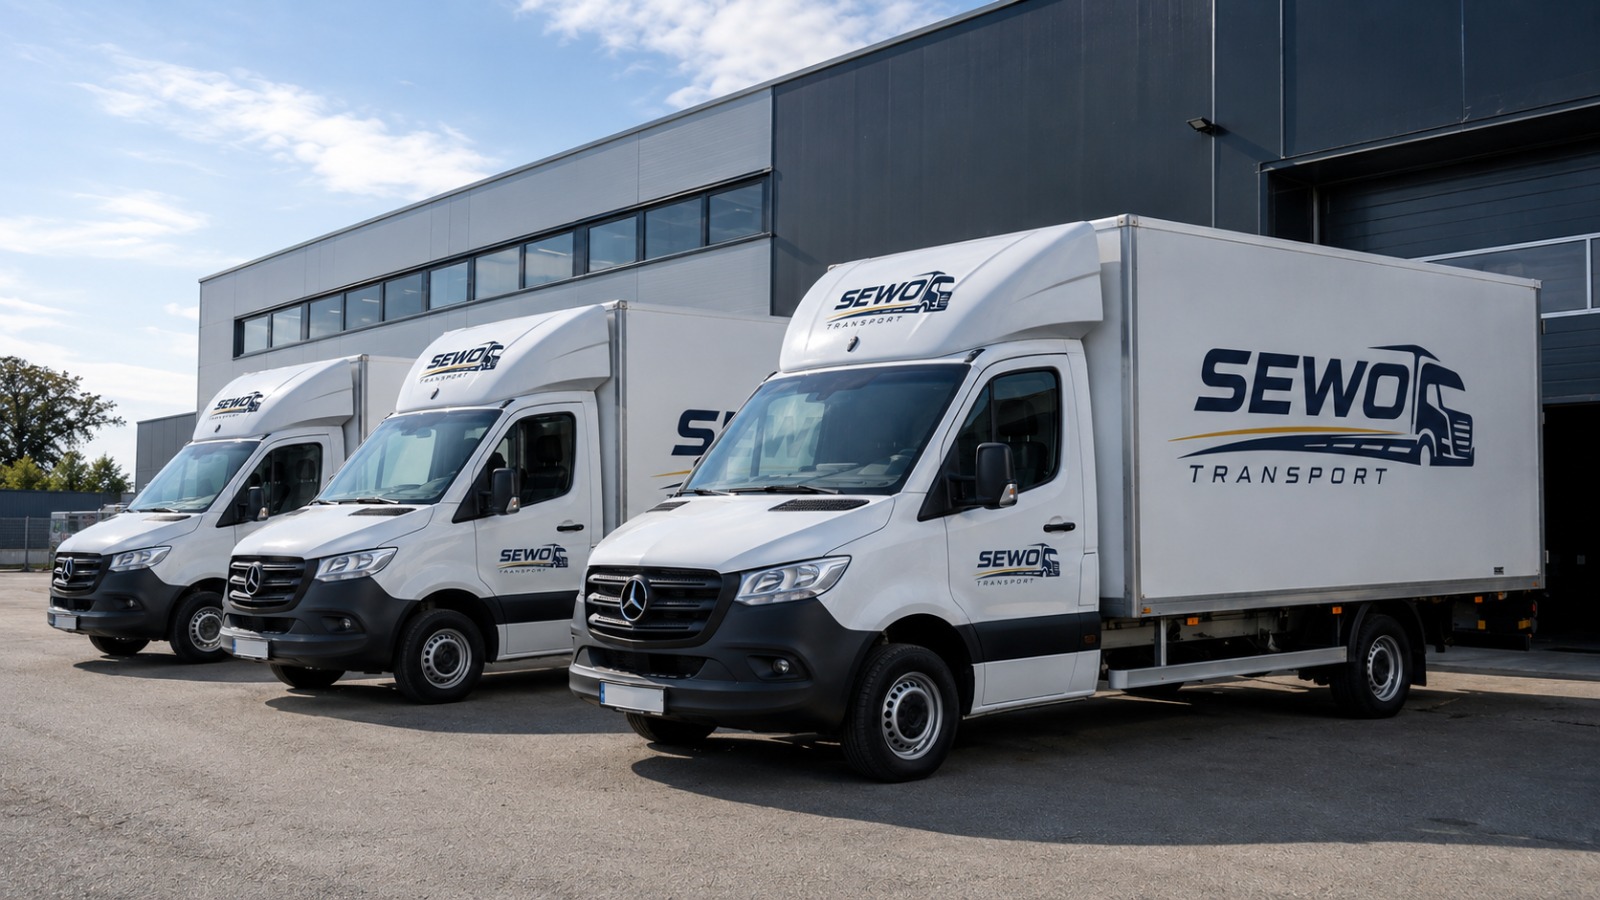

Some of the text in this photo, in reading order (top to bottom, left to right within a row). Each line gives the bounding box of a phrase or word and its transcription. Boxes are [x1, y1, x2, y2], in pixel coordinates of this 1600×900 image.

[834, 279, 928, 310] SEWO
[827, 315, 902, 329] TRANSPORT
[427, 346, 487, 369] SEWO
[1194, 348, 1410, 420] SEWO
[214, 395, 252, 410] SEWO
[1189, 464, 1388, 485] TRANSPORT
[499, 548, 552, 562] SEWO
[977, 549, 1041, 568] SEWO
[977, 578, 1034, 587] TRANSPORT
